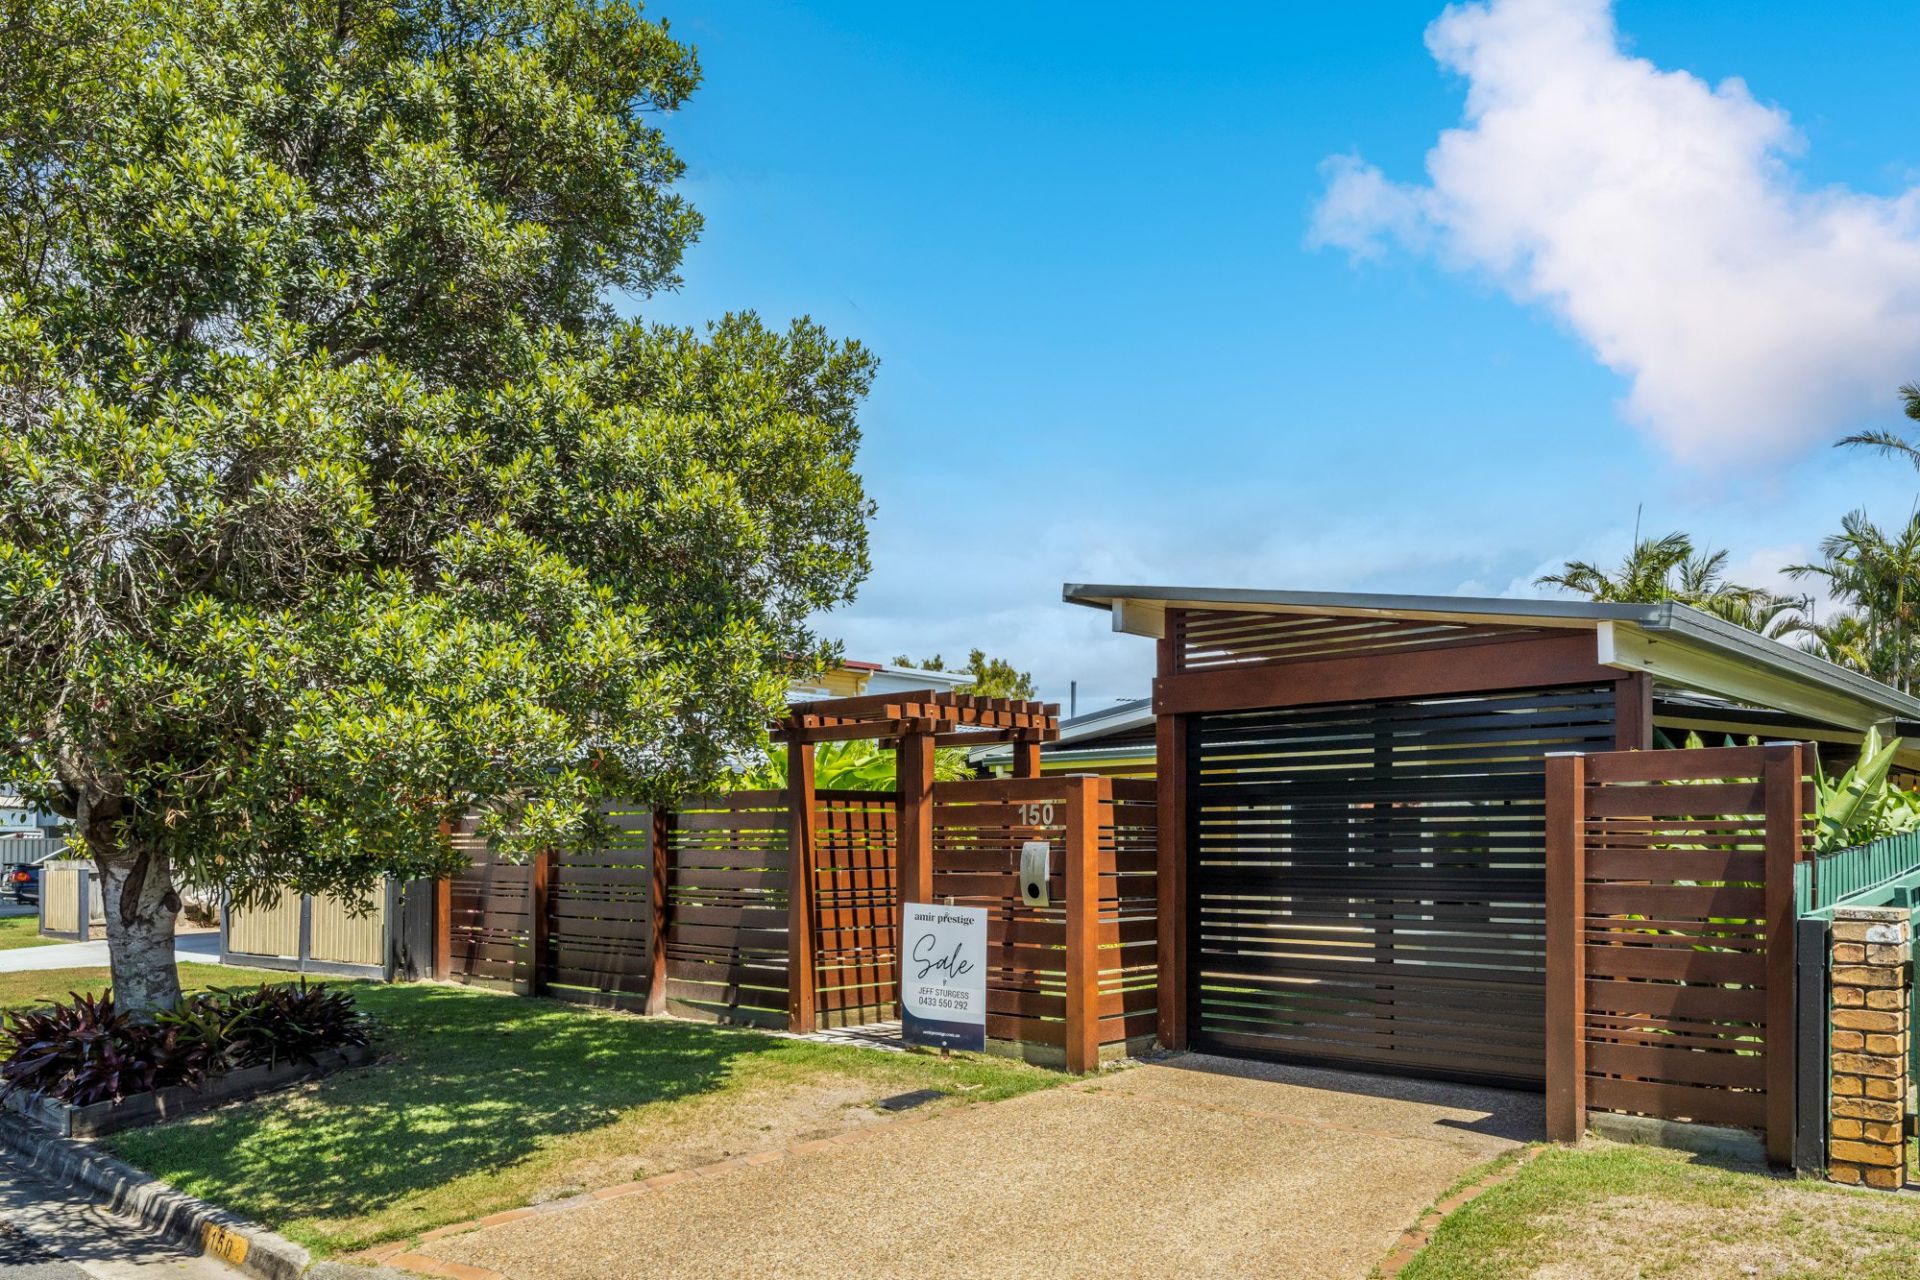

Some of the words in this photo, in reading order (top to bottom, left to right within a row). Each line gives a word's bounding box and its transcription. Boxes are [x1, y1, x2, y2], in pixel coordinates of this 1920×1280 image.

[1018, 803, 1054, 826] 150
[914, 912, 936, 922] amir
[937, 914, 975, 926] prestige
[912, 933, 975, 980] Sale
[918, 986, 934, 995] JEFF
[935, 988, 970, 1000] STURGESS
[918, 996, 937, 1007] 0433
[938, 998, 953, 1008] 550
[954, 1000, 968, 1010] 292
[210, 1231, 233, 1258] 150
